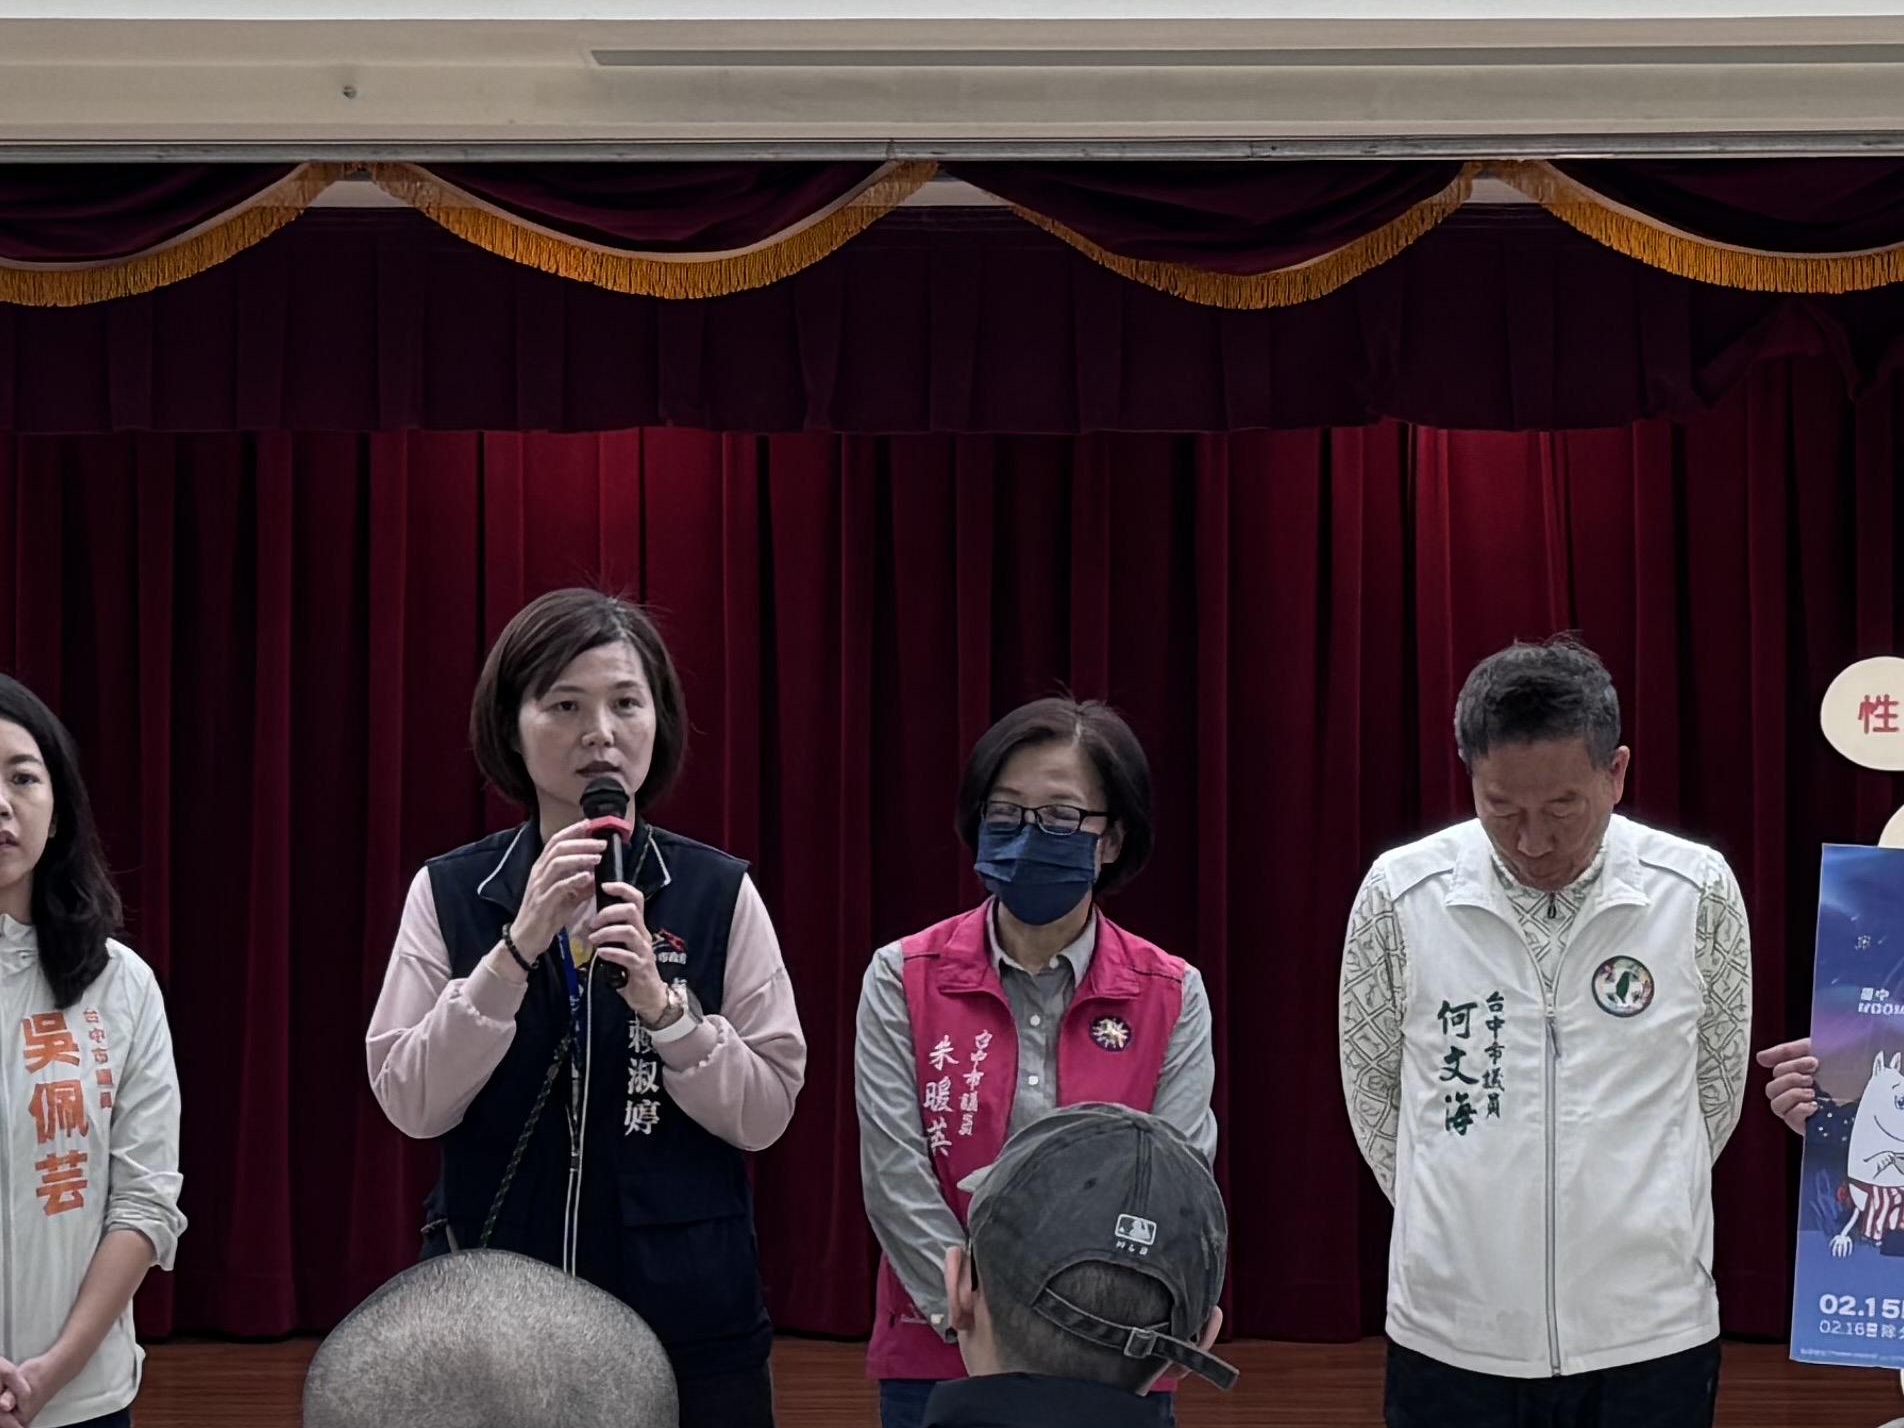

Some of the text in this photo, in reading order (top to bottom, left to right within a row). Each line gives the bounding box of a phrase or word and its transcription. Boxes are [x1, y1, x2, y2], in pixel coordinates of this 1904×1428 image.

[22, 1011, 89, 1217] 吳佩芸
[1437, 1000, 1479, 1136] 何文海
